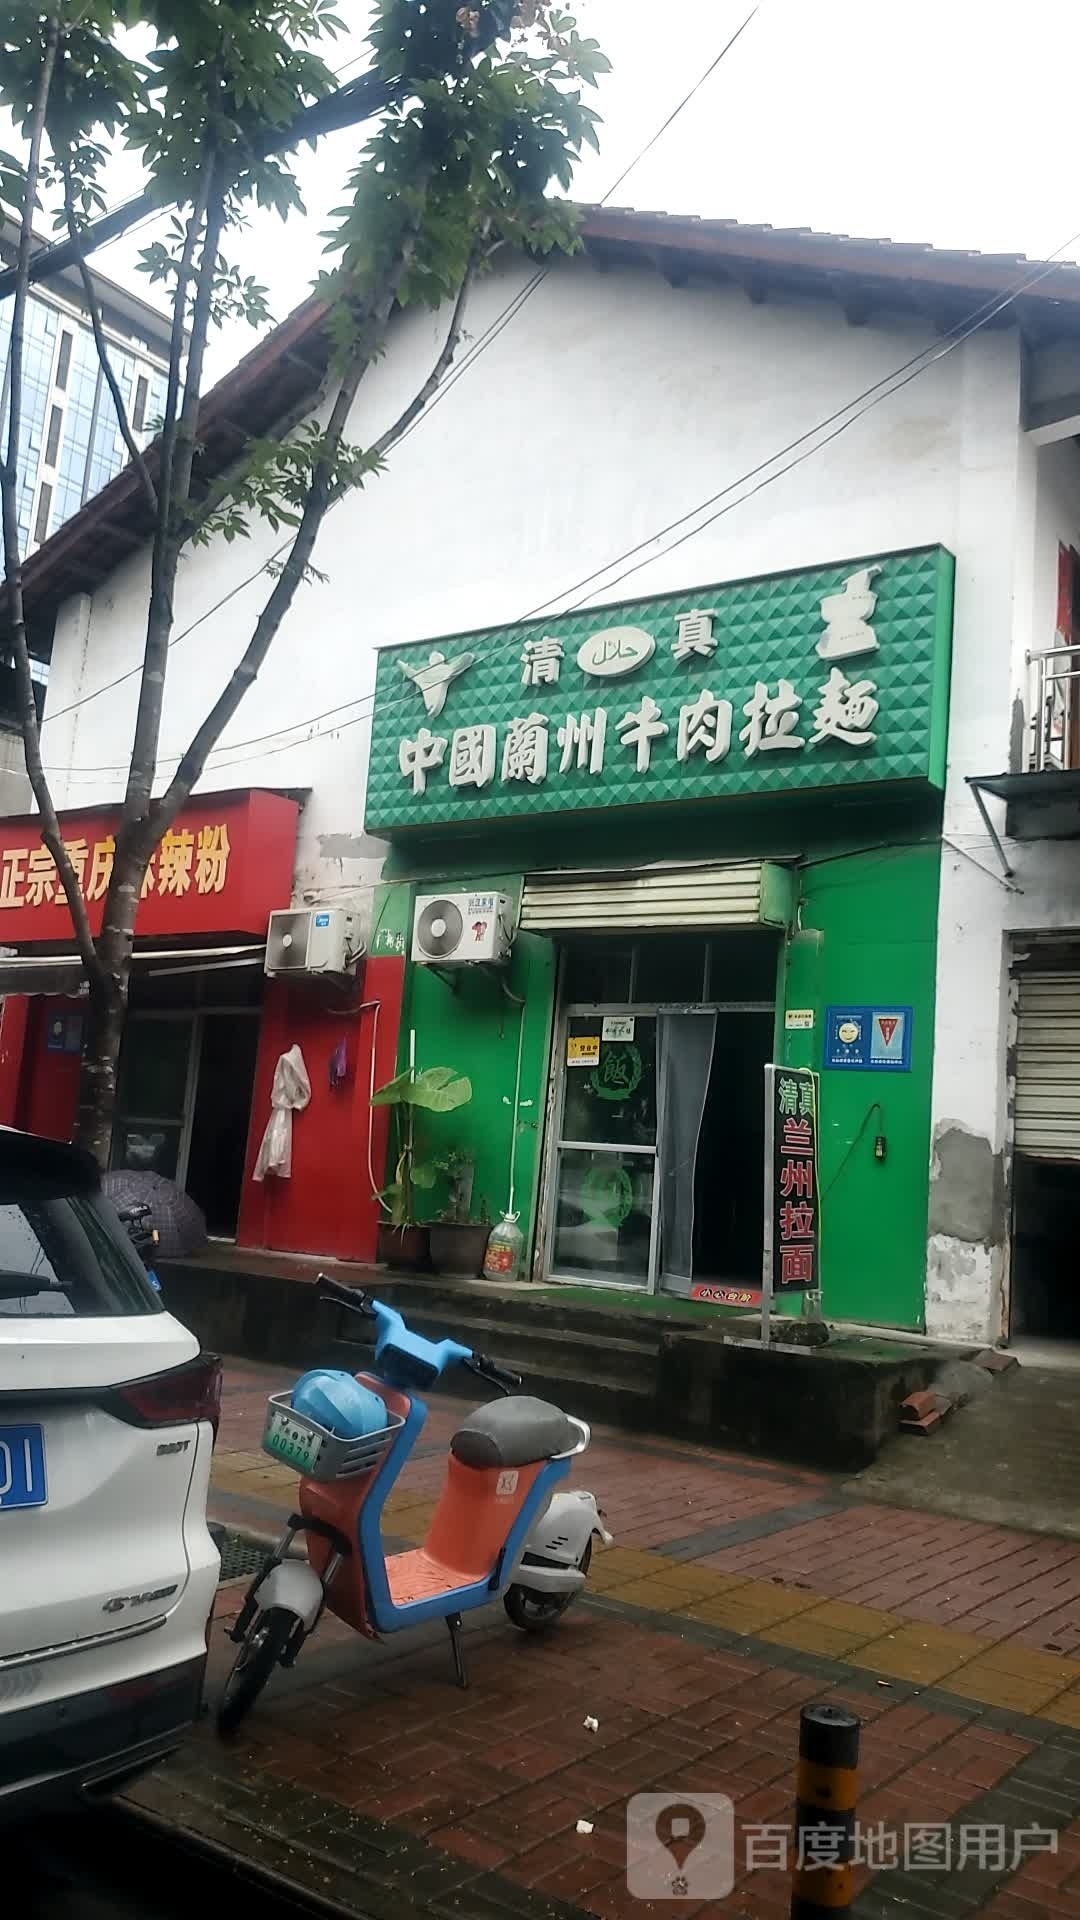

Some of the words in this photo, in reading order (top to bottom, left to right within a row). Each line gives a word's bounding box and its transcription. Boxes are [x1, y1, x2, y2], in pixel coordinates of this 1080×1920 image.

[671, 607, 719, 662] 真
[520, 636, 565, 687] 清
[0, 824, 230, 908] 正宗重庆辣粉
[778, 1077, 815, 1116] 清真
[780, 1117, 815, 1284] 兰州拉面
[272, 1434, 310, 1462] 00379
